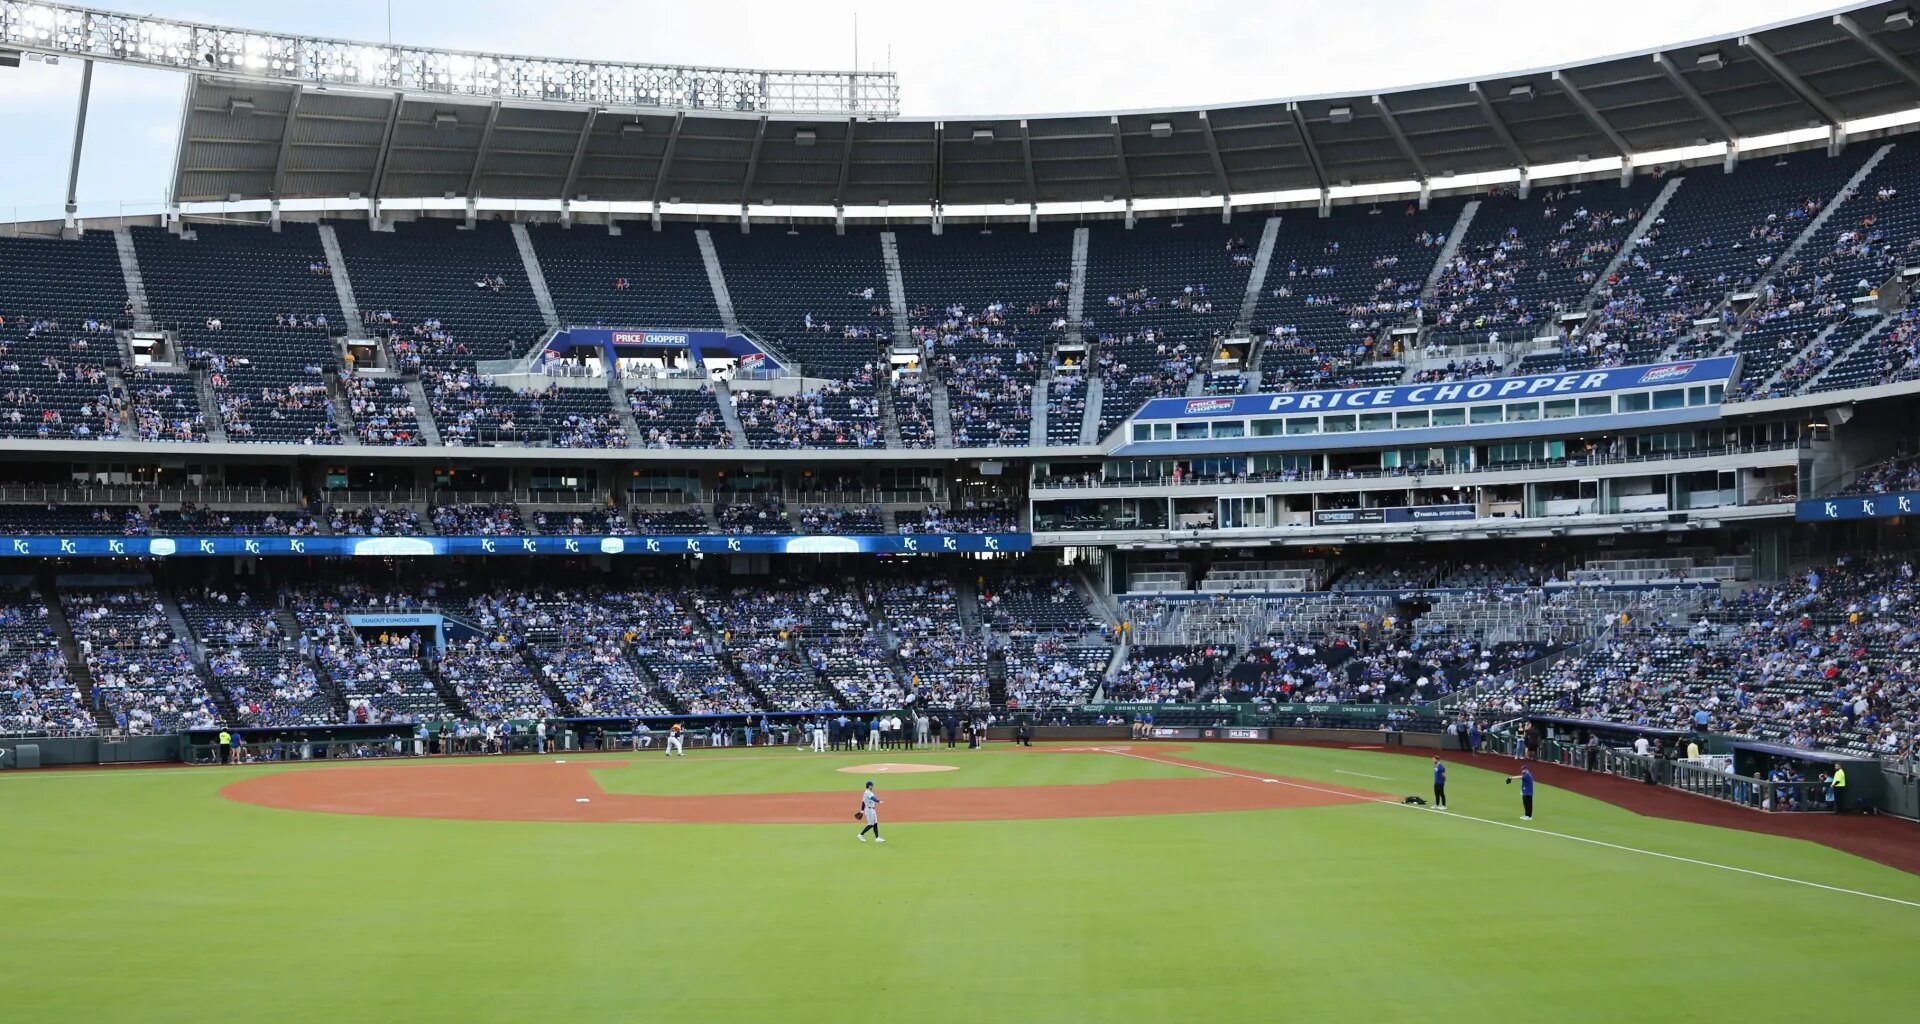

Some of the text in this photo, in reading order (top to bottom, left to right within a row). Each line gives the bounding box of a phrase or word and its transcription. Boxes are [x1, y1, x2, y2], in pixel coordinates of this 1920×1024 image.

[615, 334, 686, 344] PRICE CHOPPER
[1641, 368, 1689, 382] CHOPPER
[1268, 372, 1609, 411] PRICE CHOPPER
[1187, 403, 1231, 413] CHOPPER
[1190, 400, 1217, 408] PRICE
[1825, 502, 1837, 518] KC
[1862, 499, 1875, 516] KC
[1898, 496, 1911, 512] KC
[13, 539, 29, 554] KC
[61, 539, 76, 554] KC
[109, 539, 124, 554] KC
[200, 539, 215, 554] KC
[245, 539, 260, 554] KC
[290, 539, 304, 554] KC
[481, 538, 495, 553] KC
[522, 538, 536, 552] KC
[565, 538, 579, 553] KC
[645, 538, 660, 552] KC
[686, 538, 700, 552] KC
[727, 537, 740, 552] KC
[903, 536, 917, 551] KC
[943, 536, 957, 550] KC
[983, 536, 998, 550] KC
